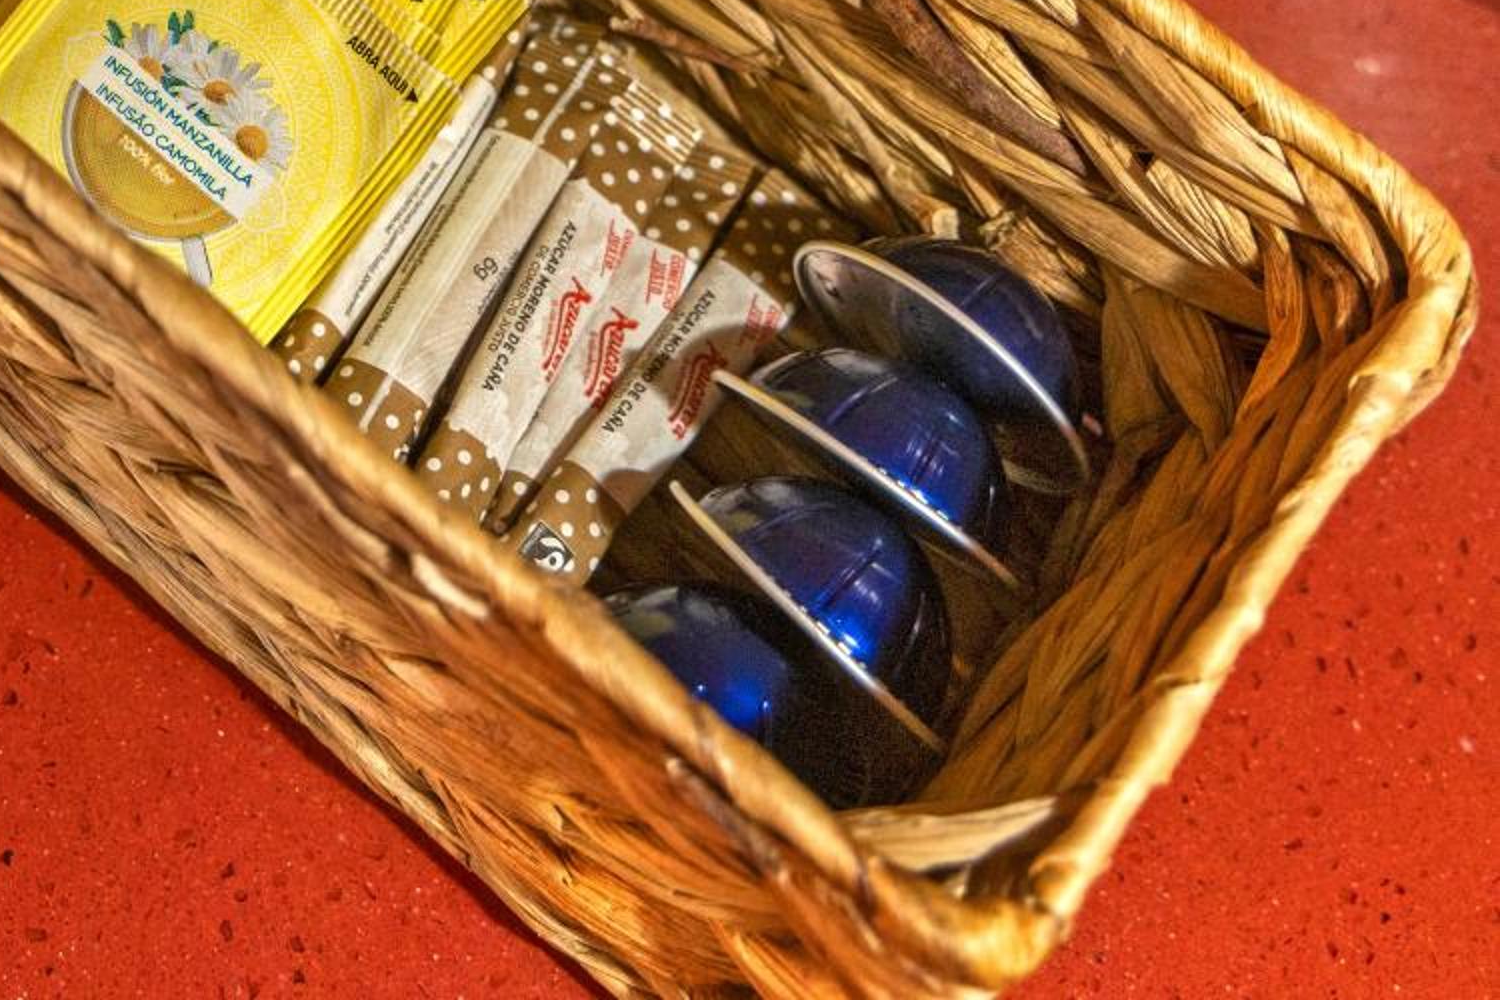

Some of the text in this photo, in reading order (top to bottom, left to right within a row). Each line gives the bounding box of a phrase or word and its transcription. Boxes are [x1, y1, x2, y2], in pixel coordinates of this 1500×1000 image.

[346, 36, 379, 69] ABRA
[104, 55, 253, 187] INFUSIÓN MANZANILLA
[95, 83, 227, 201] INFUSÃO CAMOMILA
[473, 256, 499, 281] 6g
[515, 276, 550, 329] MORENO
[504, 332, 520, 354] DE
[644, 333, 684, 387] MORENO
[481, 354, 510, 392] CAÑA
[628, 382, 647, 402] DE
[602, 400, 634, 433] CAÑA
